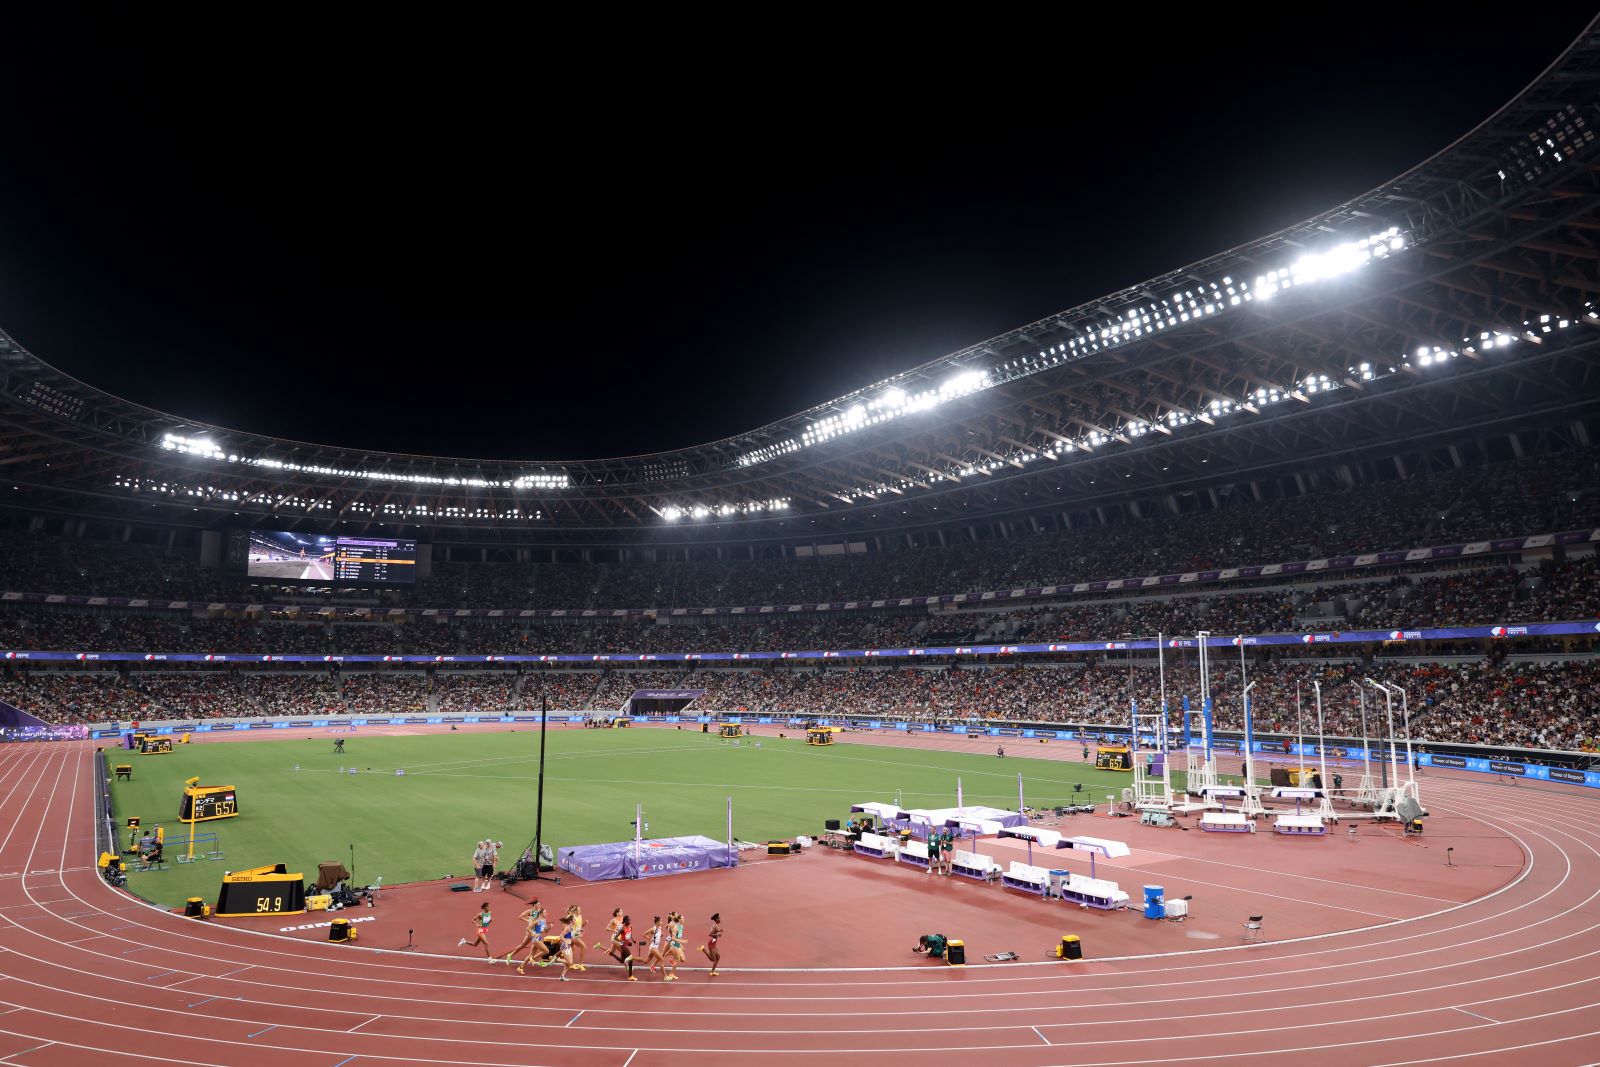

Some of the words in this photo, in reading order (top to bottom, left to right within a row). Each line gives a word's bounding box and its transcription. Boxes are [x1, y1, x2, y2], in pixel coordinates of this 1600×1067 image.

[1449, 759, 1465, 767] Respect
[1507, 765, 1523, 773] Respect
[1567, 772, 1584, 781] Respect
[215, 800, 235, 816] 6.57
[256, 896, 282, 912] 54.9
